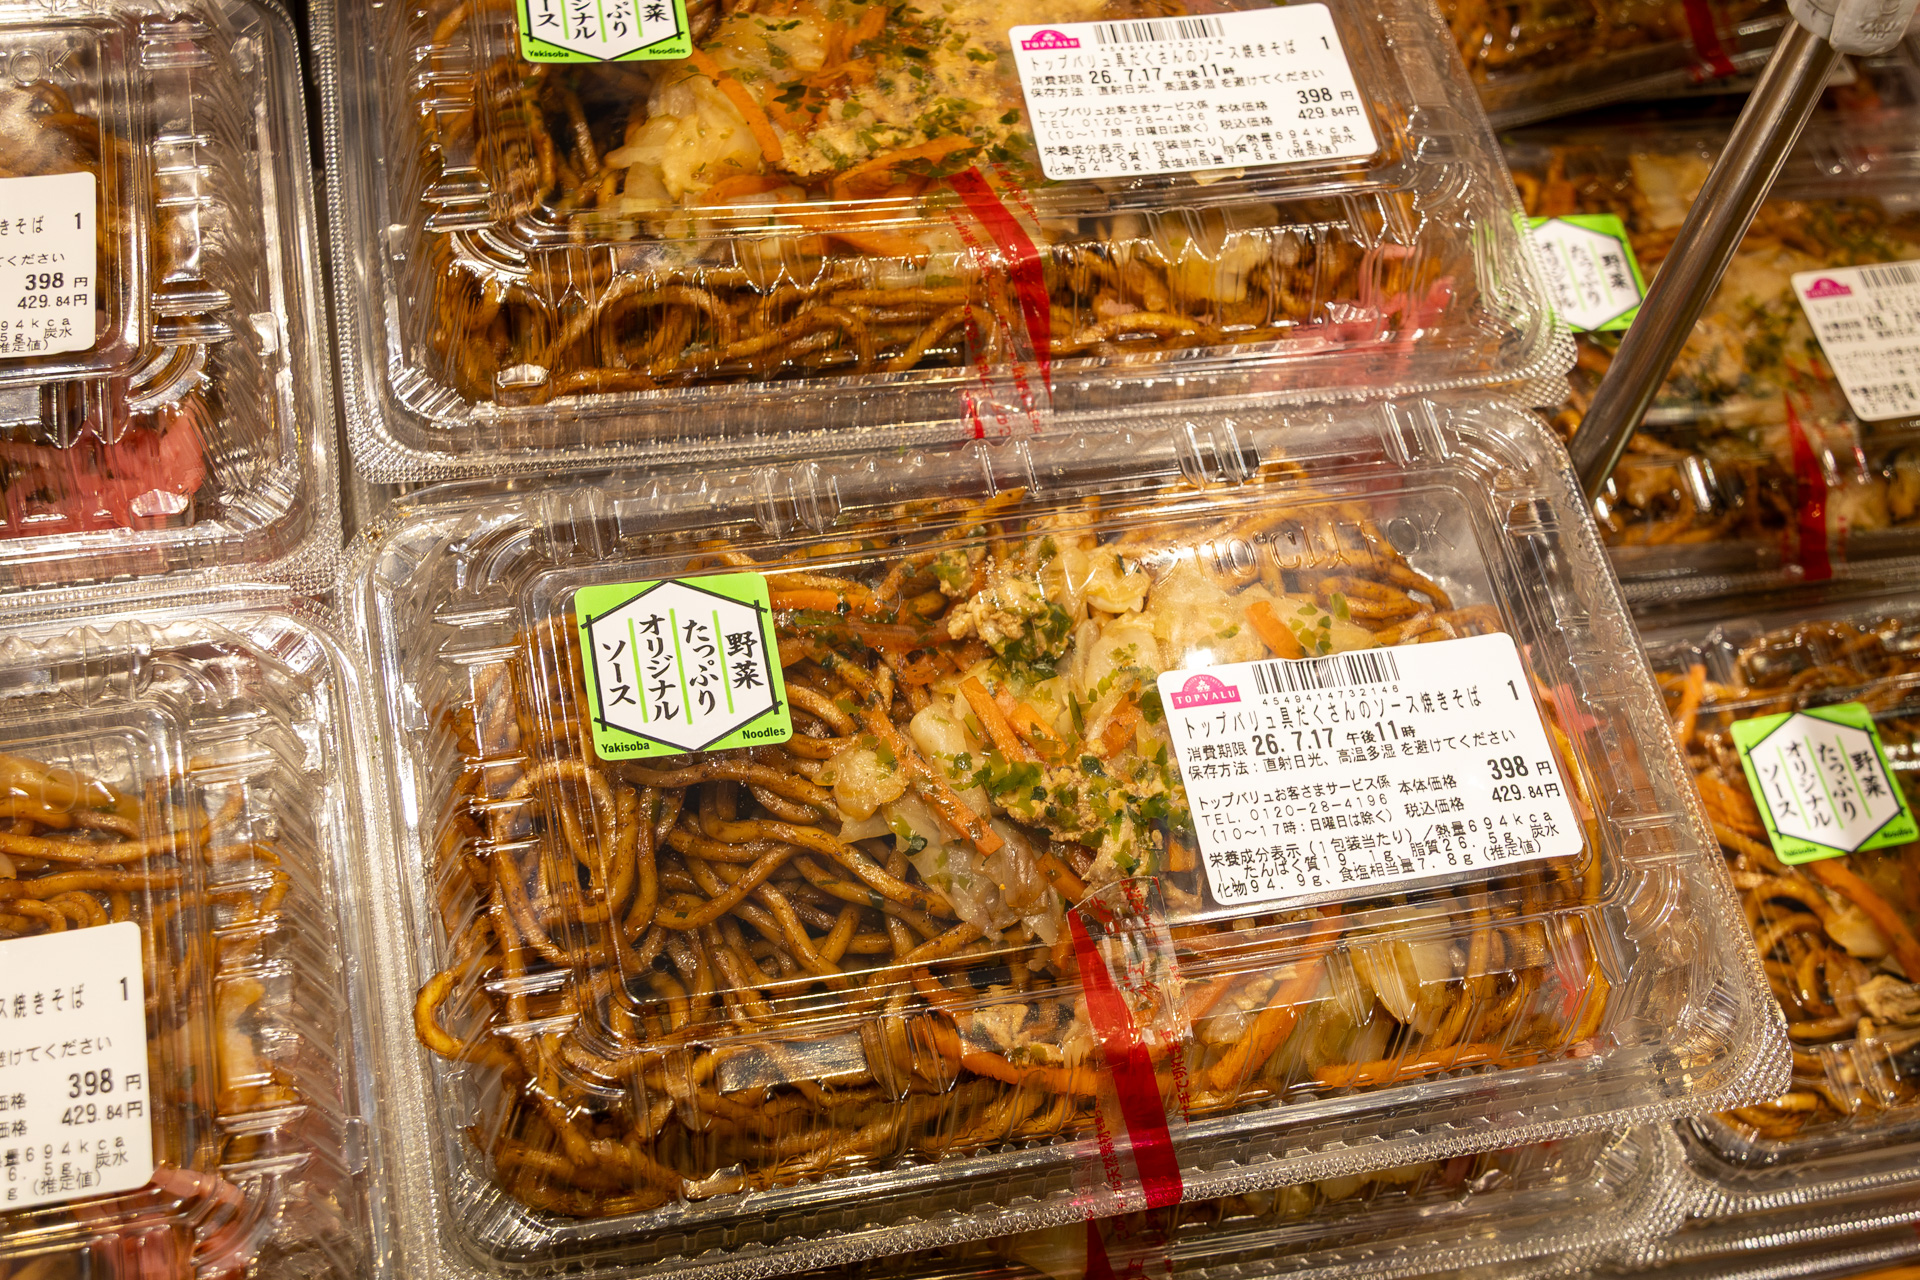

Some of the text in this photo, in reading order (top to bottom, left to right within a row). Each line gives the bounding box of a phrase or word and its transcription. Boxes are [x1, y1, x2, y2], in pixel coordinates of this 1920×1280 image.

[643, 0, 669, 23] 菜
[528, 50, 570, 58] Yakisoba
[1023, 40, 1078, 48] TOPVALU
[1320, 36, 1330, 50] 1
[1031, 74, 1084, 87] 消費期限
[1215, 101, 1269, 114] 本体価格
[1297, 87, 1355, 104] 398 円
[1219, 115, 1273, 130] 税込価格
[74, 212, 81, 230] 1
[0, 253, 65, 268] ください
[25, 272, 88, 291] 398 円
[639, 614, 679, 722] オリジナル
[682, 619, 719, 716] たっぷり
[725, 630, 764, 690] 野菜
[602, 640, 636, 706] ソース
[1175, 690, 1236, 705] TOPVALU
[1184, 680, 1519, 739] トップバリュ具だくさんのソース焼きそば 1
[601, 727, 786, 754] Noodles Yakisoba
[1187, 741, 1248, 763] 消費期限
[1346, 720, 1416, 746] 午後11時
[1487, 755, 1553, 780] 398 円
[1851, 750, 1887, 798] 野菜
[1198, 774, 1457, 811] トップバリュお客さまサービス係 本体価格
[1763, 764, 1798, 817] ソース
[1786, 741, 1831, 827] オリジナル
[1818, 744, 1857, 821] たっぷり
[1404, 797, 1465, 818] 税込価格
[120, 977, 129, 1001] 1
[68, 1068, 114, 1099] 398
[125, 1073, 142, 1092] 円
[0, 1136, 125, 1168] 量694kca
